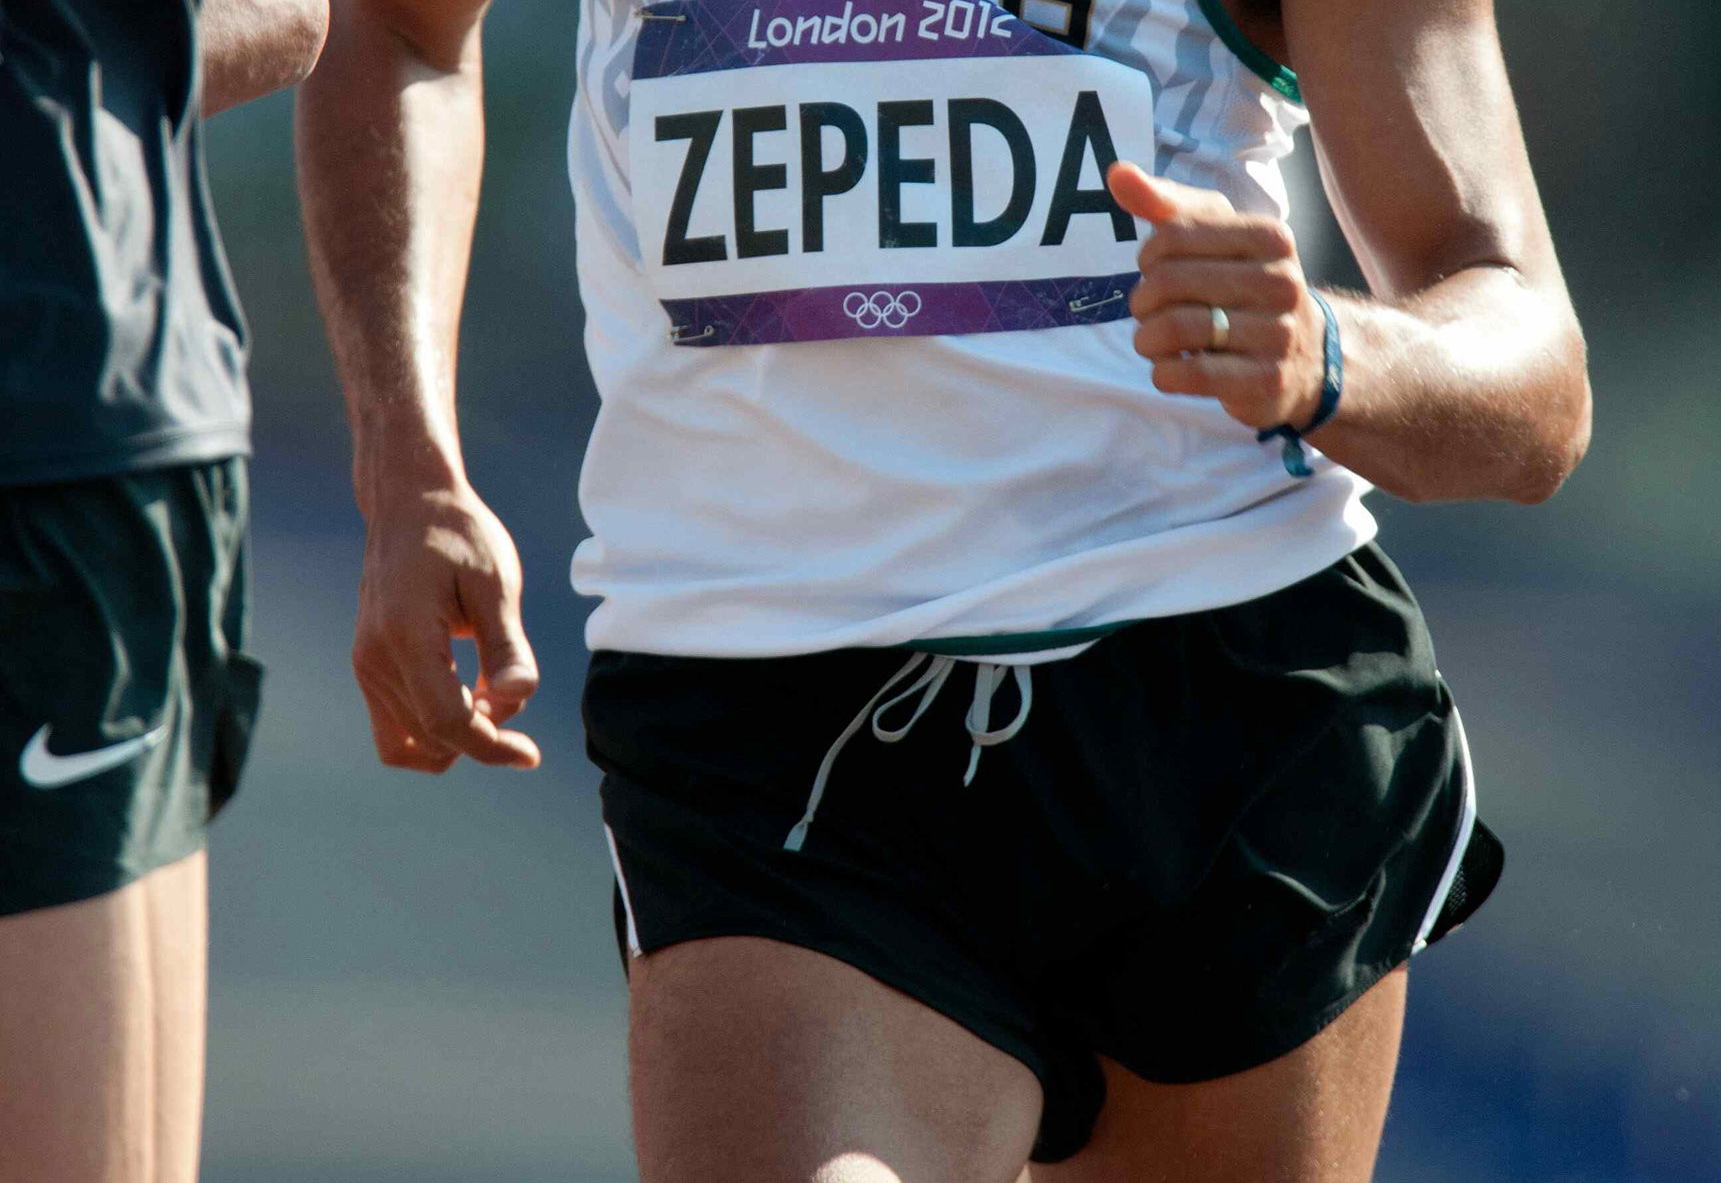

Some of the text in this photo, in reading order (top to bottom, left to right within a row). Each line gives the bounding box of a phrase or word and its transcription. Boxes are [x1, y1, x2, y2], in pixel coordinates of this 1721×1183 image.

[748, 0, 1017, 49] London 2012
[654, 90, 1138, 266] ZEPEDA
